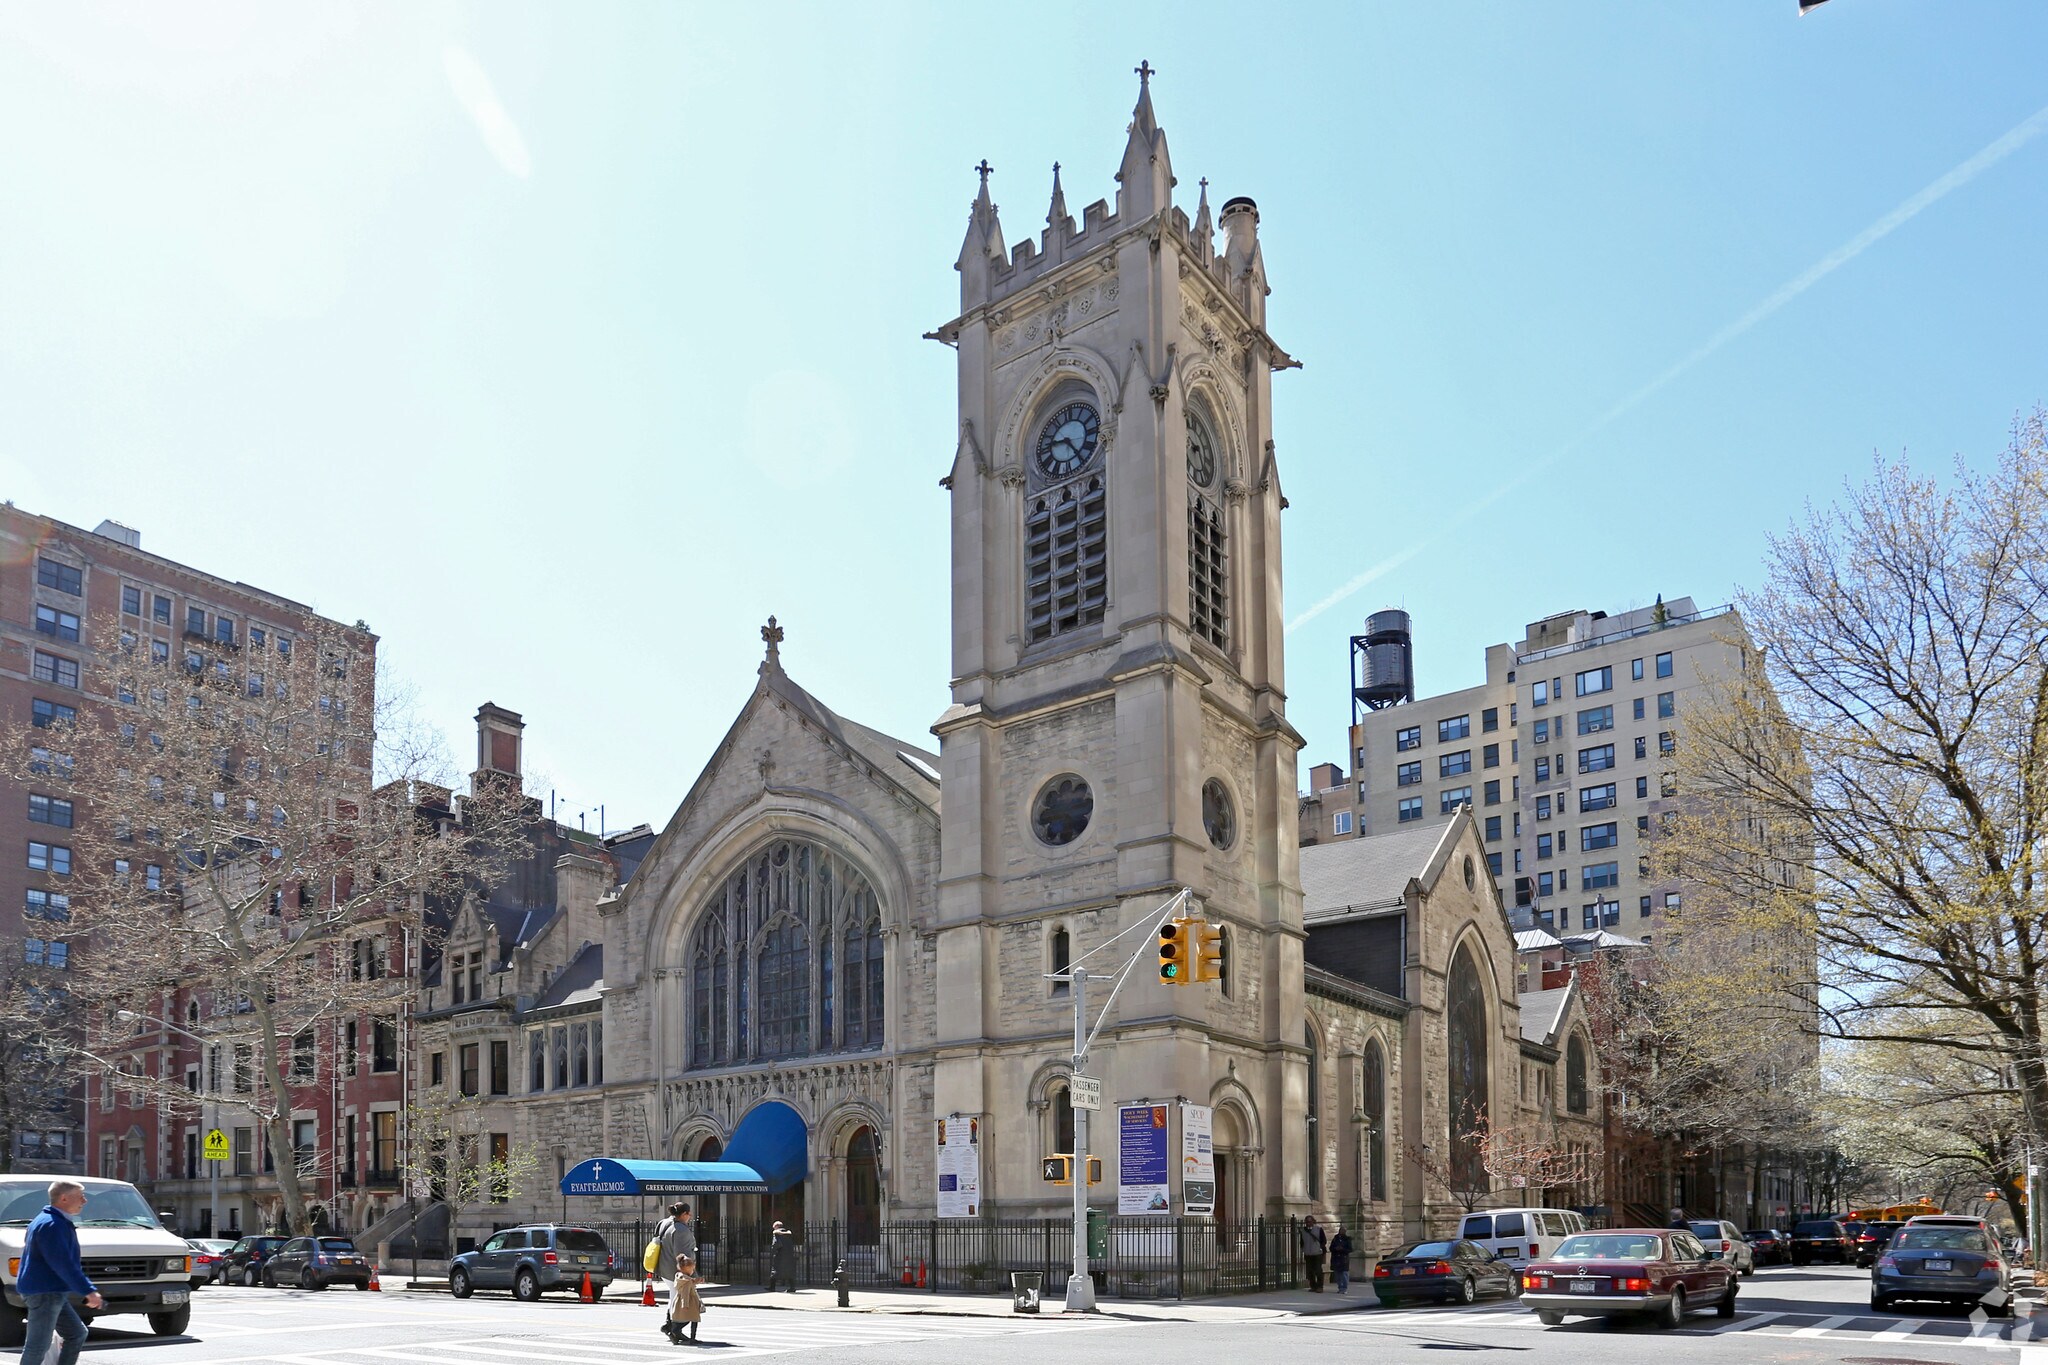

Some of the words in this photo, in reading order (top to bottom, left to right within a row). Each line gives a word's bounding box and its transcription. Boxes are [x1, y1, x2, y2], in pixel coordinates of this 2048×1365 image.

[1073, 1079, 1099, 1092] PASSENGER
[1073, 1092, 1085, 1103] CARS
[1088, 1095, 1099, 1105] ONLY
[571, 1182, 625, 1192] ΕΥΑΓΓΕΛΙΣΜΟΣ
